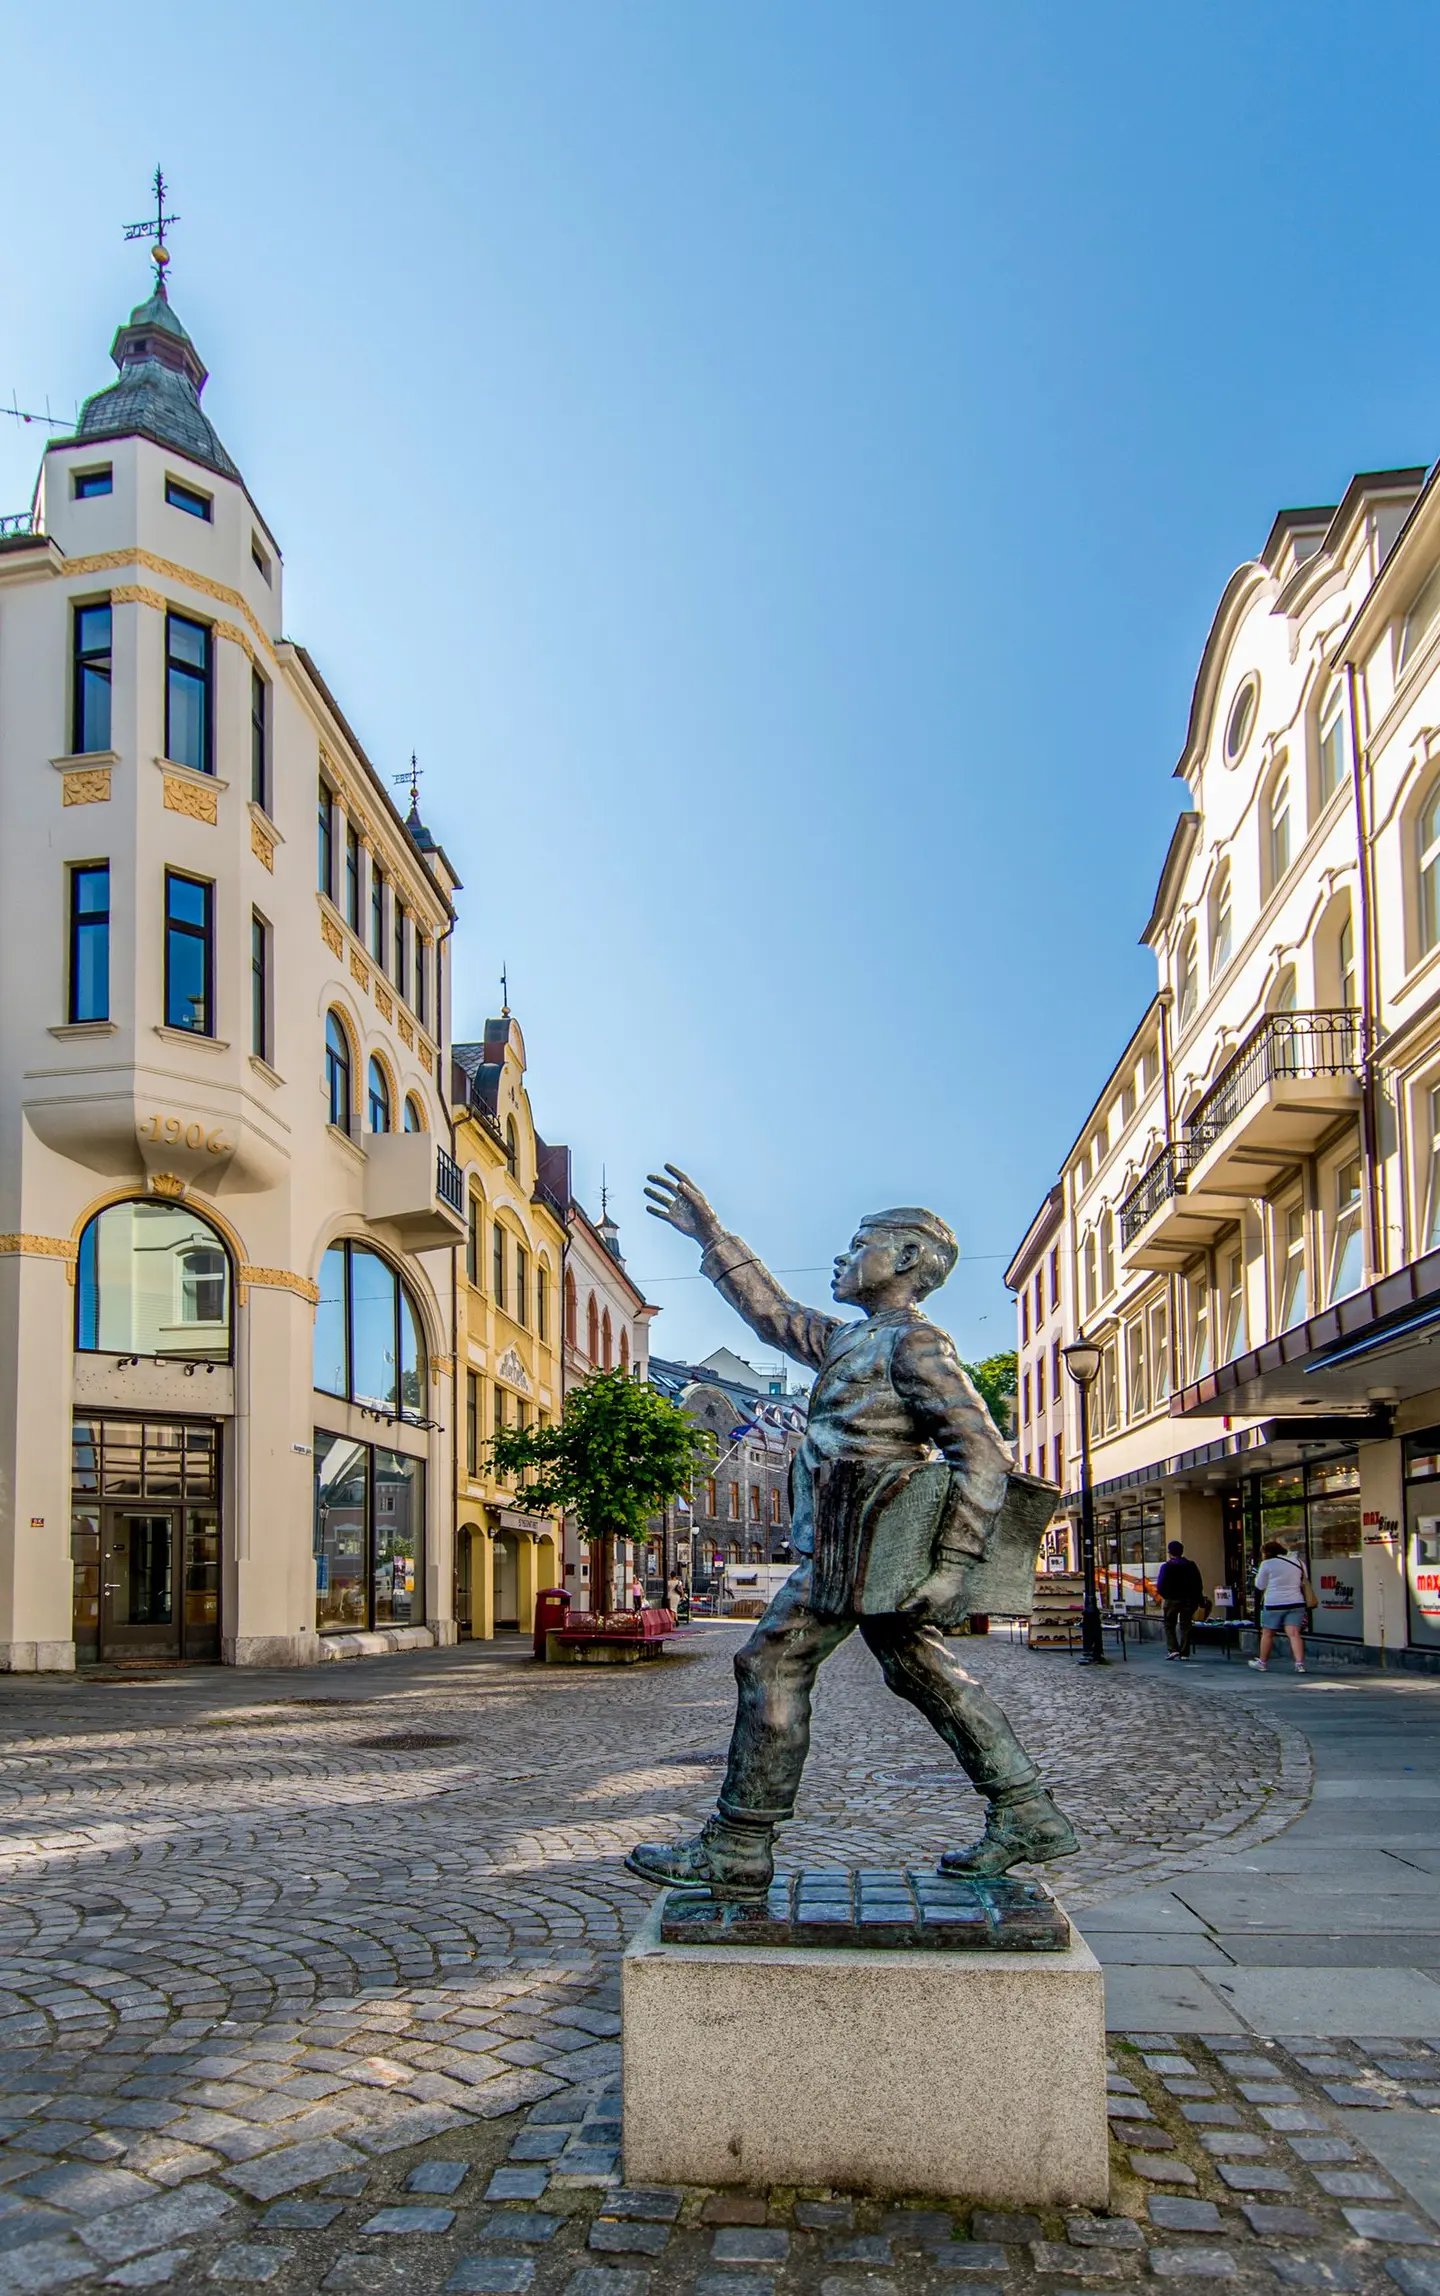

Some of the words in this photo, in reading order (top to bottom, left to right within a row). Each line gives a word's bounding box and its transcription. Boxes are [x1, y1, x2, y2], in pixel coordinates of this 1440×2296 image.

[147, 1113, 224, 1154] 1906
[1363, 1511, 1380, 1526] MAX
[1379, 1515, 1398, 1534] Bingo
[1320, 1575, 1337, 1589] MAX
[1335, 1581, 1354, 1600] Bingo
[1417, 1574, 1440, 1591] MAX
